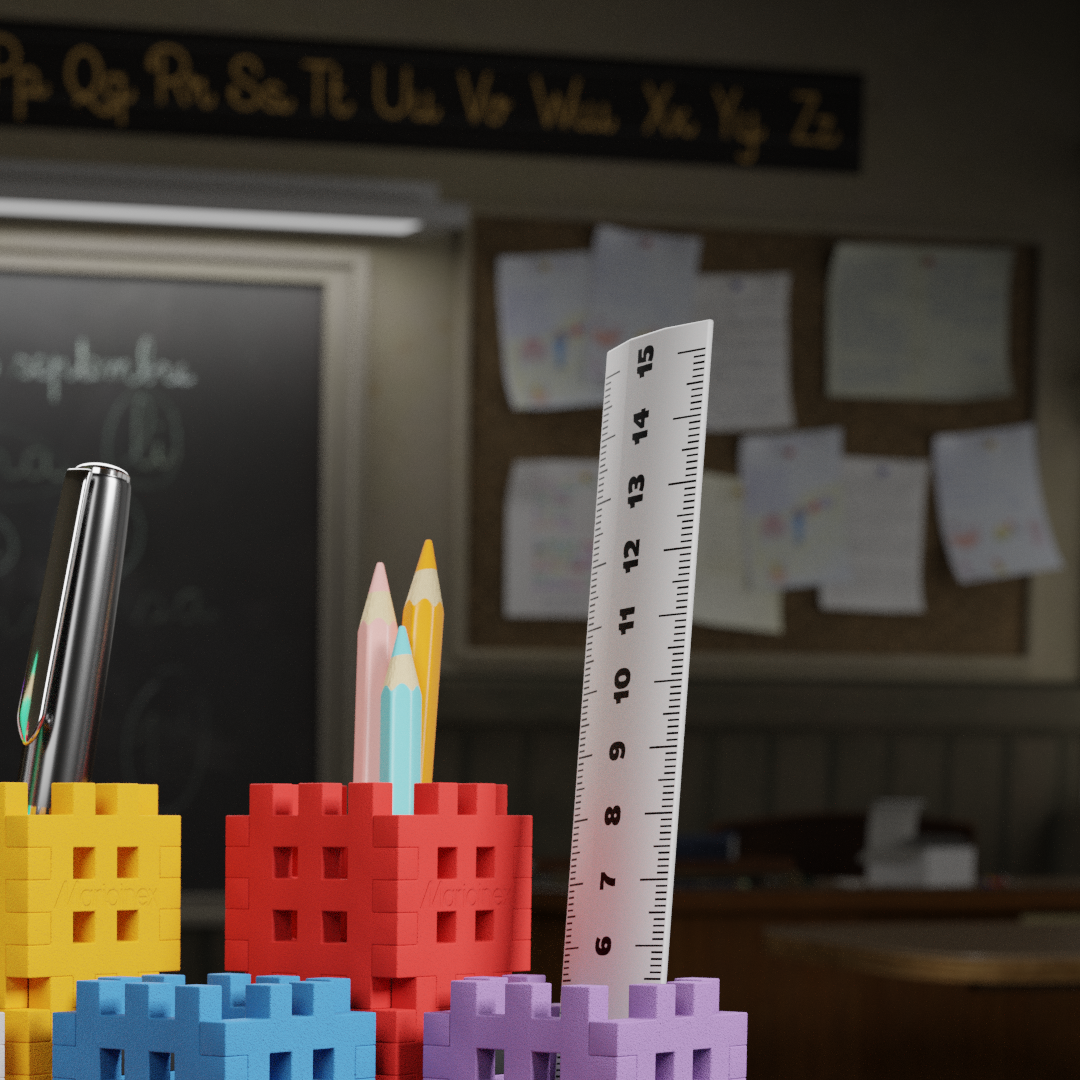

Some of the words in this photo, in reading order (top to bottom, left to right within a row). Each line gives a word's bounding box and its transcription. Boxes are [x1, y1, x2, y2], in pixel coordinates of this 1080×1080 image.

[61, 43, 140, 127] Qq
[143, 41, 218, 111] Rr
[371, 60, 445, 126] Uu
[454, 66, 516, 129] Vv
[639, 78, 701, 140] Xx
[708, 82, 769, 167] Yy
[788, 87, 845, 149] Zz
[637, 345, 654, 378] 15
[632, 408, 649, 445] 14
[628, 474, 645, 508] 13
[623, 539, 640, 573] 12
[619, 606, 635, 635] 11
[613, 667, 631, 704] 10
[609, 741, 625, 761] 9
[604, 805, 621, 825] 8
[600, 872, 616, 890] 7
[595, 936, 612, 956] 6
